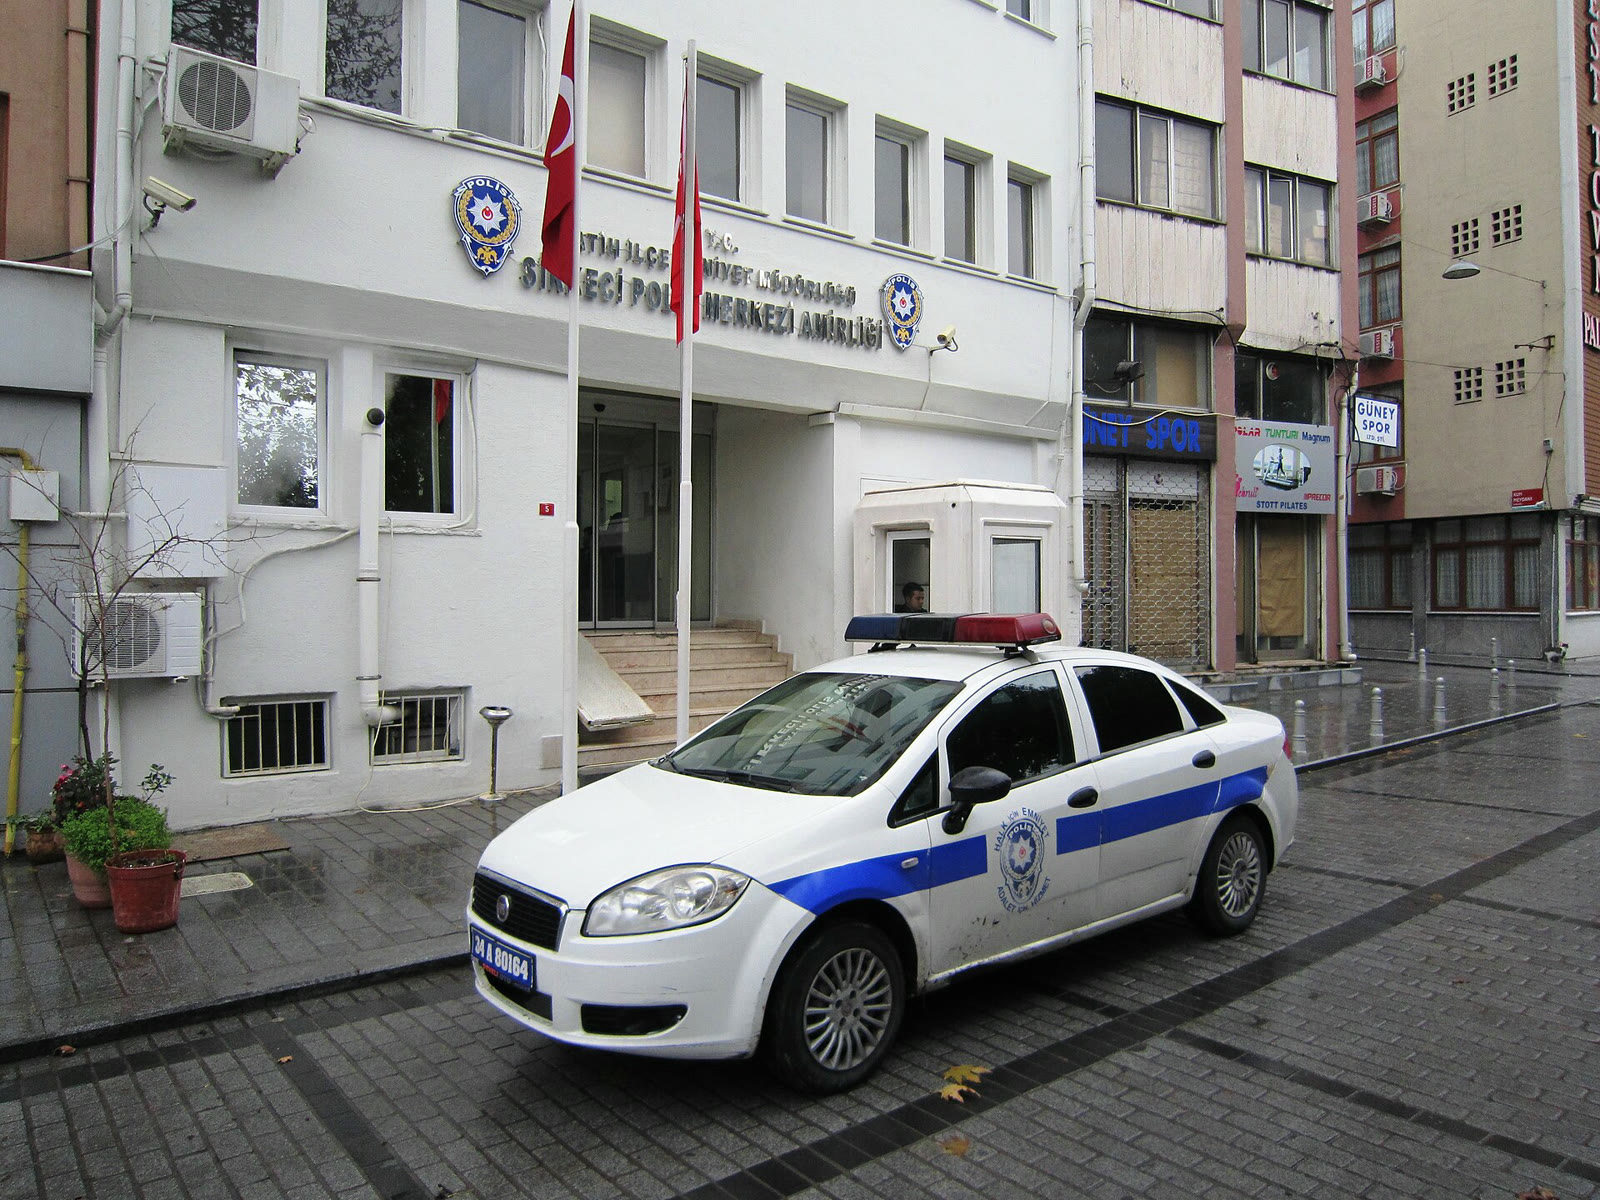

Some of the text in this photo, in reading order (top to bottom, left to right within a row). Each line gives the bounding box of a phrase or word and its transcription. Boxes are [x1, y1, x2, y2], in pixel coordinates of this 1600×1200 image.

[580, 232, 620, 260] ATİH
[625, 238, 671, 270] İLÇE
[702, 256, 754, 286] NİYET
[520, 256, 883, 350] SİECİ POL MERKEZİ AMİRLİĞİ
[1083, 406, 1200, 452] NEY SPOR
[1357, 401, 1395, 421] GÜNEY
[1362, 419, 1391, 434] SPOR
[1265, 428, 1299, 440] TUNTURI
[1302, 431, 1331, 445] Magnum
[1256, 501, 1308, 510] STOTT PILATES
[994, 822, 1008, 852] HALK
[1022, 807, 1050, 838] EMNİYET
[998, 885, 1016, 913] ADALET
[475, 935, 484, 958] 34
[486, 942, 493, 963] A
[494, 947, 529, 980] 80164
